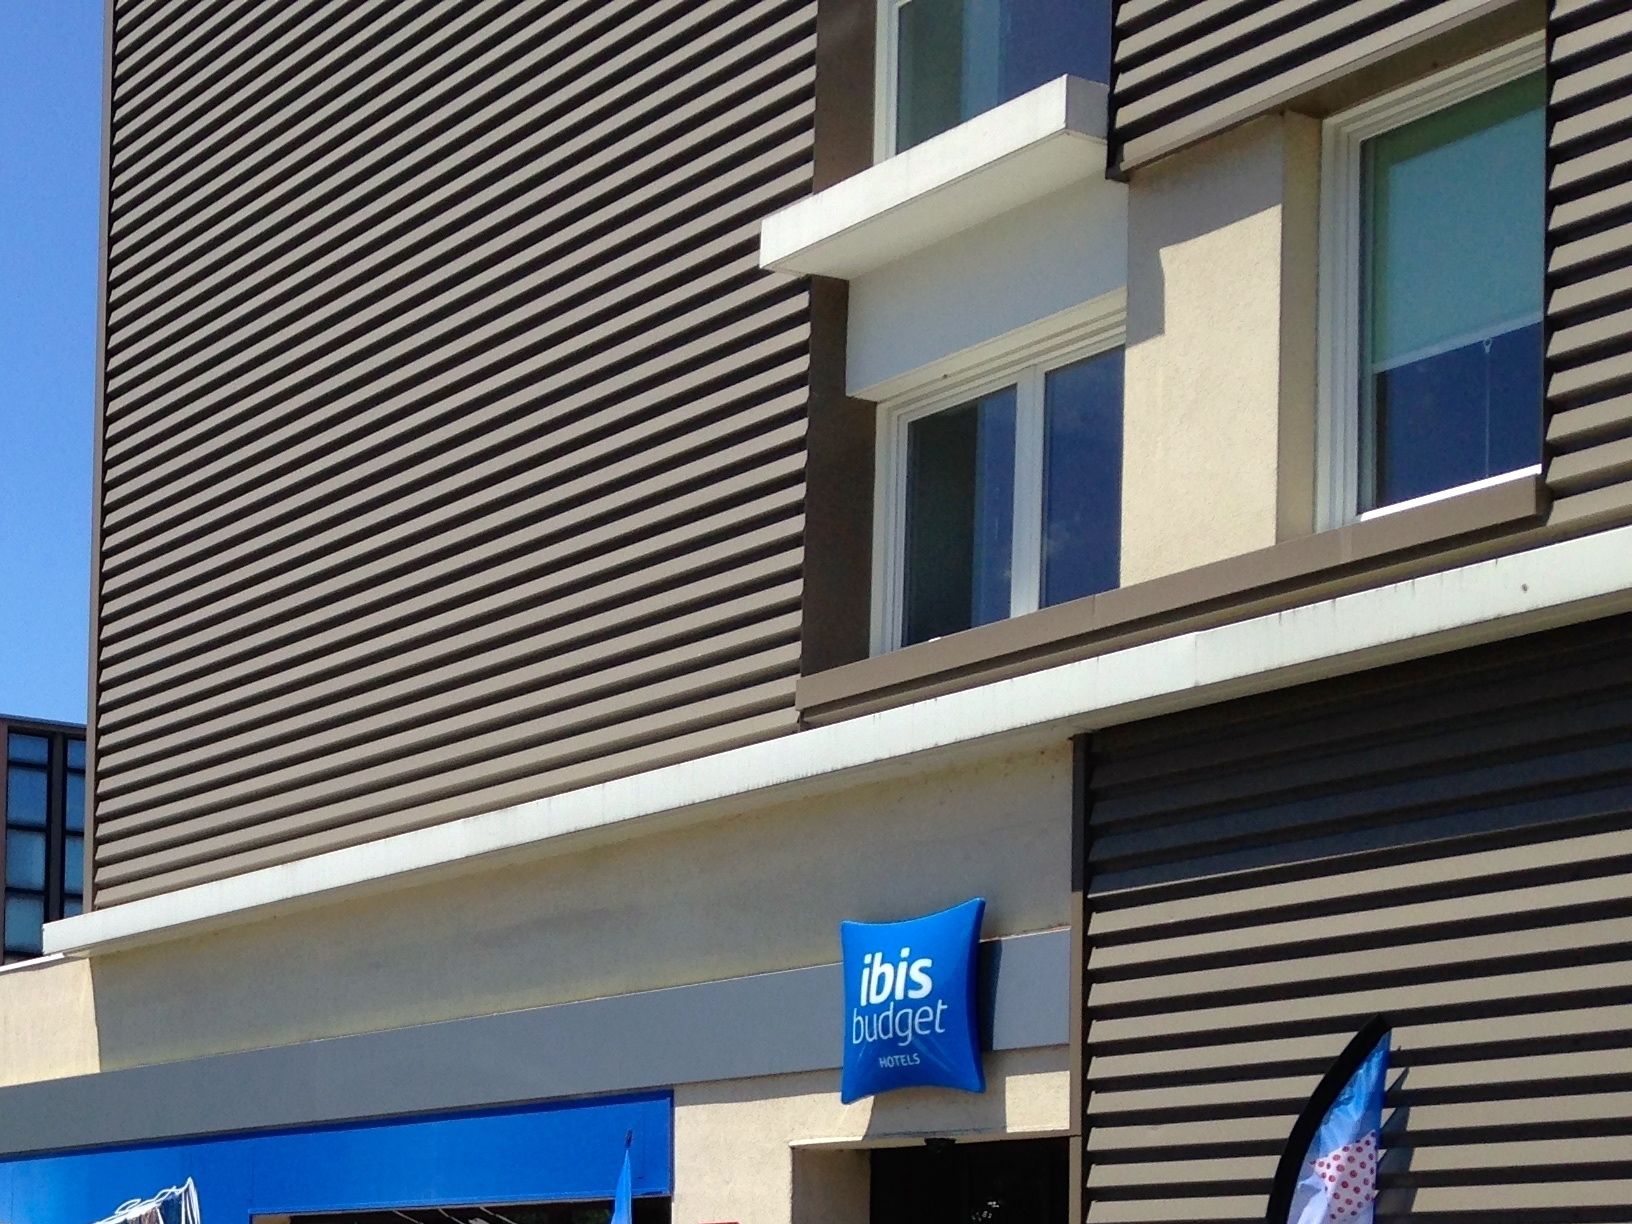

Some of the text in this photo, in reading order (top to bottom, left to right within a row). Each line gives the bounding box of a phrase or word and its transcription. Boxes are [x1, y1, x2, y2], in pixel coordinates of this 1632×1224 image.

[860, 947, 933, 1007] ibis
[852, 999, 948, 1046] budget
[879, 1053, 920, 1068] HOTELS
